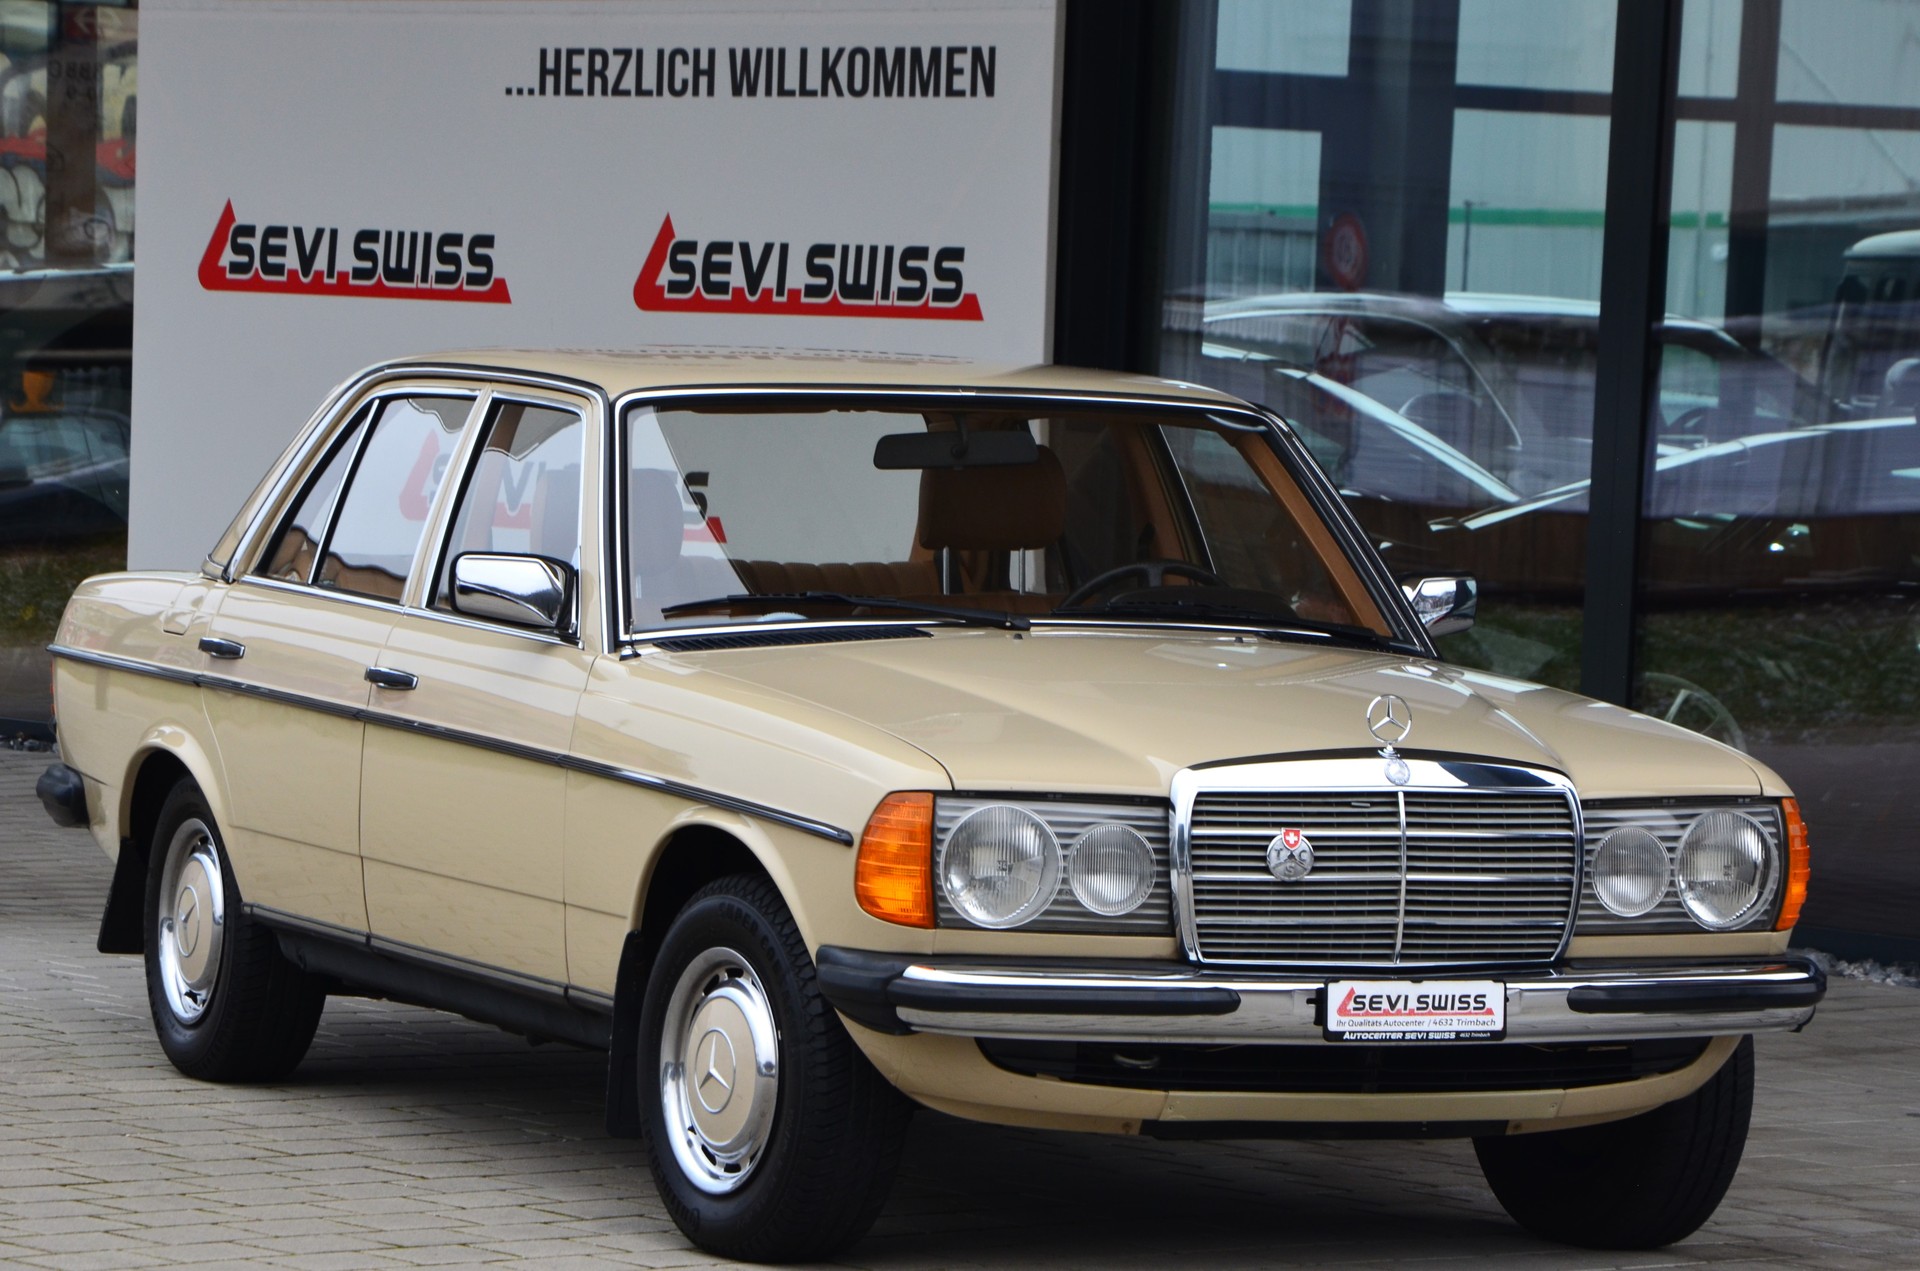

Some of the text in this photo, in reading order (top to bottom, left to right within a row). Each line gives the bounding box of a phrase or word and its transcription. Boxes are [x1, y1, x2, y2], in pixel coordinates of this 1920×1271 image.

[505, 45, 997, 98] ...HERZLICH WILLKOMMEN
[227, 223, 496, 288] SEVI SWISS
[664, 239, 966, 304] SEVI SWISS
[1352, 994, 1487, 1012] SEVI SWISS
[1336, 1019, 1346, 1027] Ihr
[1385, 1019, 1425, 1028] Autocenter
[1432, 1018, 1454, 1027] 4632
[1456, 1018, 1496, 1027] Trimbach
[1404, 1032, 1427, 1040] SEVI
[1427, 1031, 1456, 1040] SWISS
